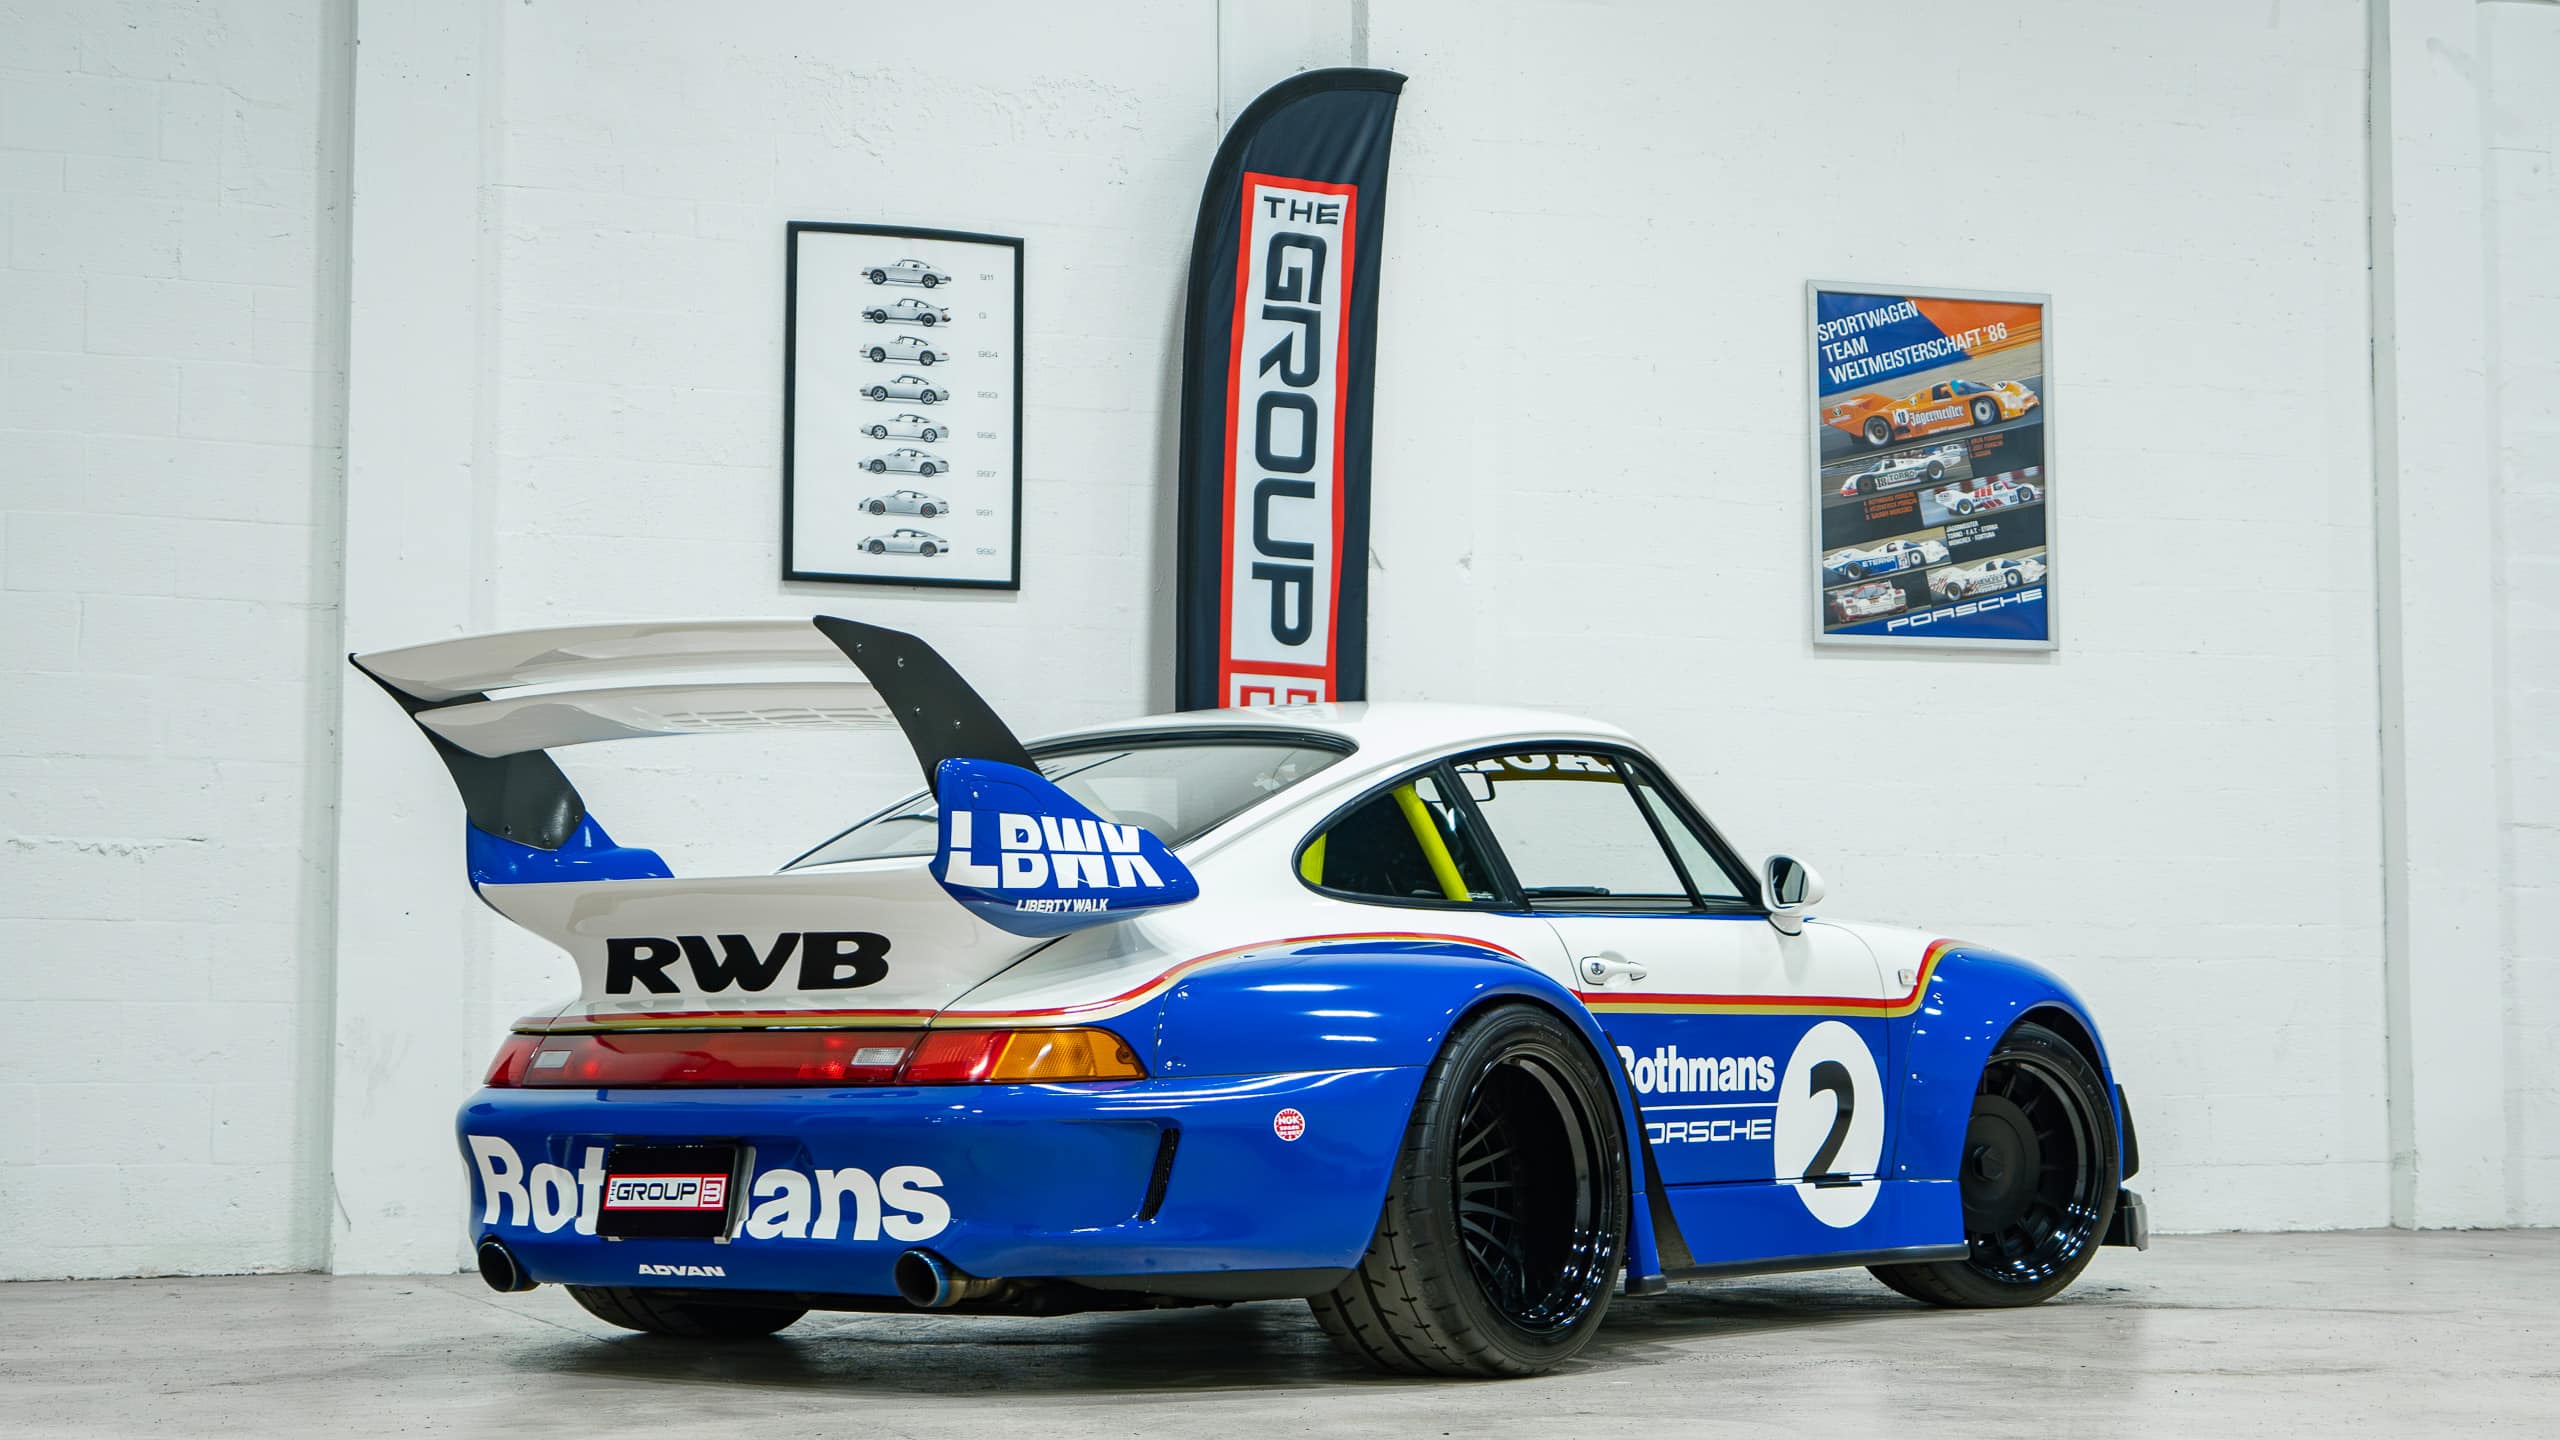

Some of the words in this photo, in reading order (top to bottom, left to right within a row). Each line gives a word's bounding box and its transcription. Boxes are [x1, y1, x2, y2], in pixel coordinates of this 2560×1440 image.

[1263, 196, 1340, 225] THE
[1818, 300, 1919, 342] SPORTWAGEN
[1822, 336, 1869, 363] TEAM
[1829, 328, 1982, 385] WELTMEISTERSCHAFT
[1982, 321, 2009, 343] '86
[1252, 231, 1328, 647] GROUP
[1887, 588, 2043, 632] PORSCHE
[944, 810, 1165, 888] LBWK
[1016, 898, 1073, 913] LIBERTY
[1073, 897, 1110, 912] WALK
[605, 931, 892, 995] RWB
[1645, 1118, 1772, 1144] ORSCHE
[1802, 1060, 1863, 1190] 2
[467, 1134, 951, 1242] Rotans
[616, 1182, 698, 1201] GROUP
[638, 1264, 727, 1277] ADVAN
